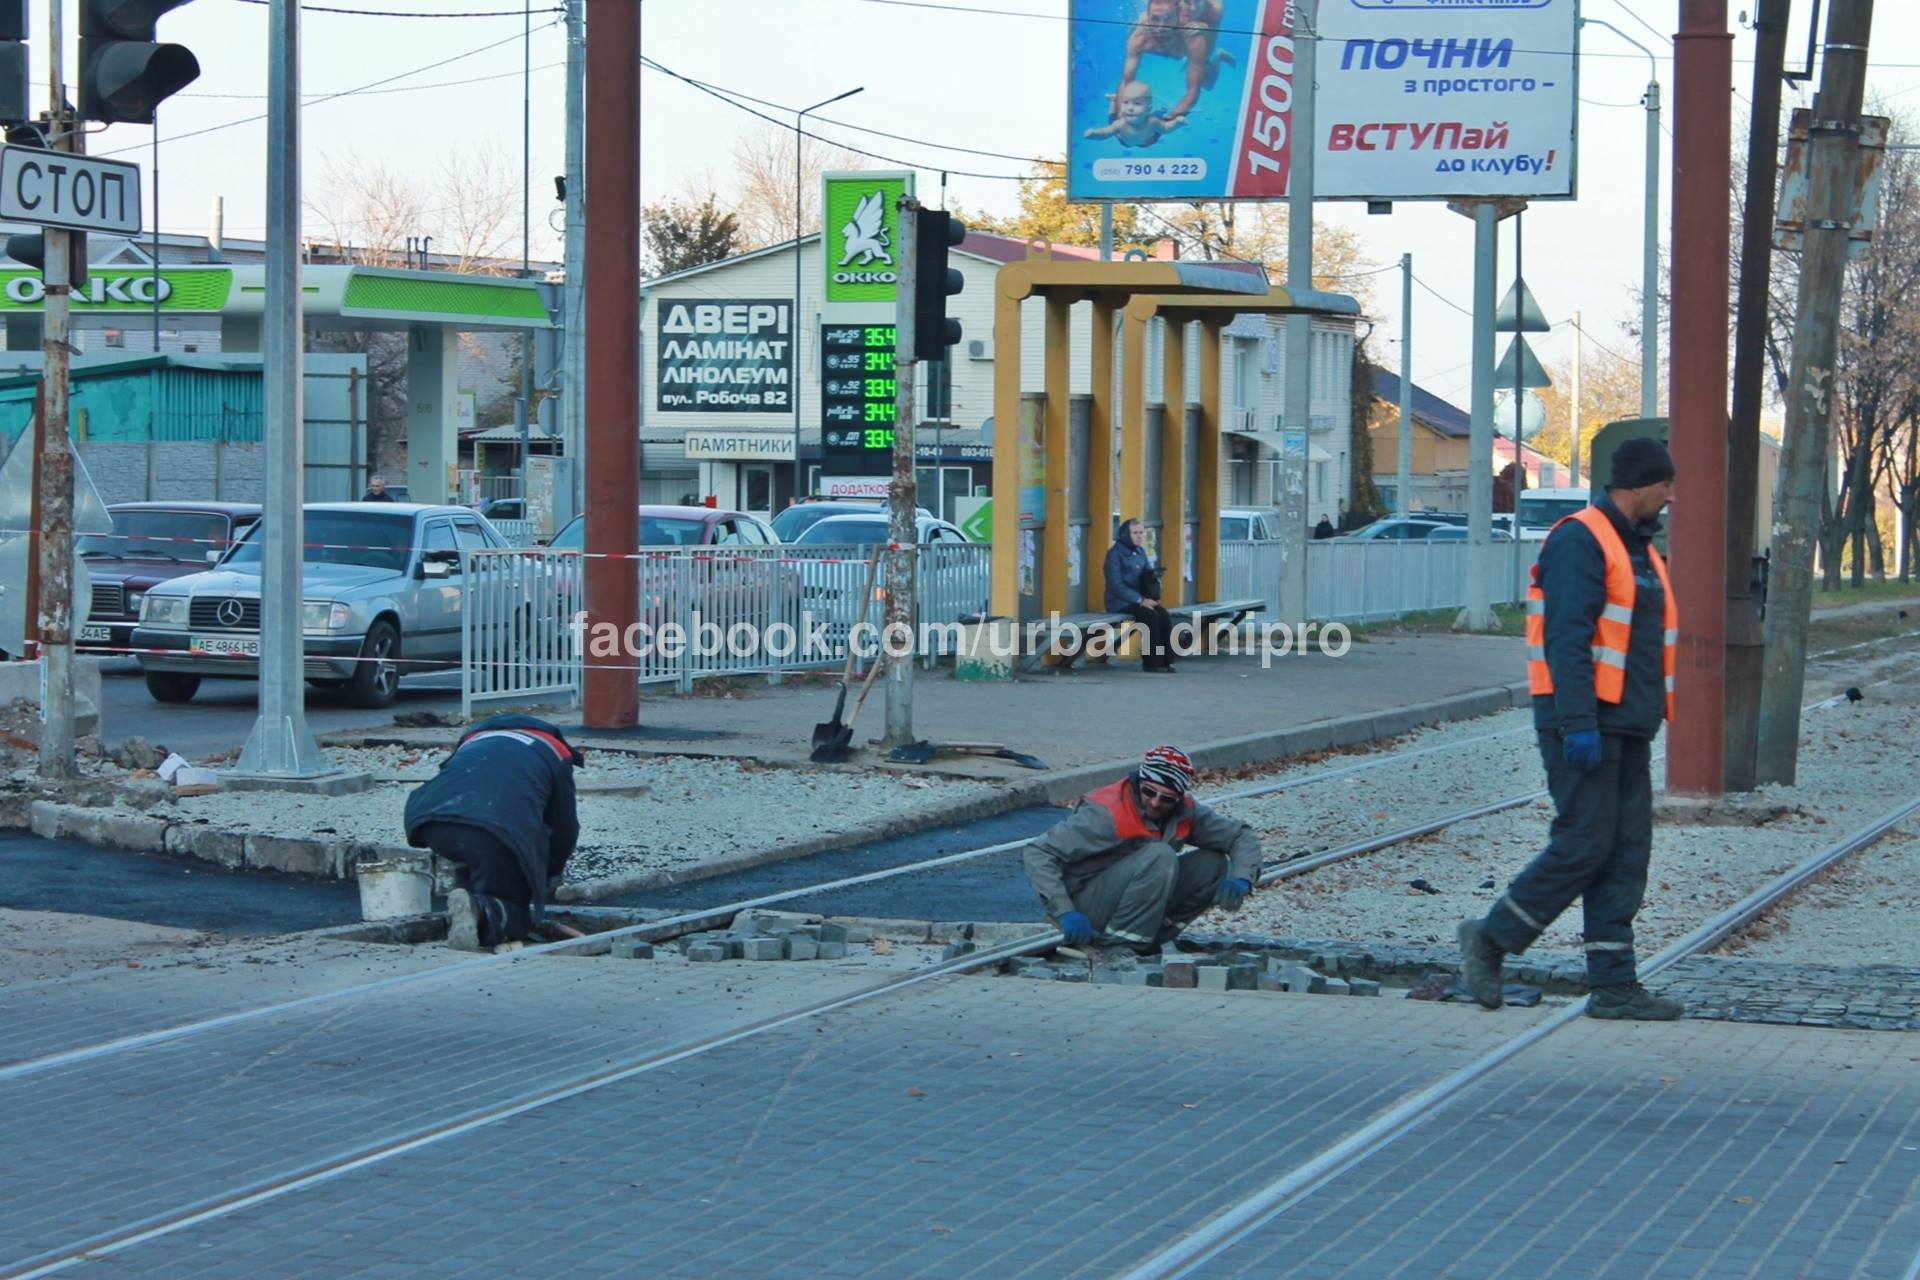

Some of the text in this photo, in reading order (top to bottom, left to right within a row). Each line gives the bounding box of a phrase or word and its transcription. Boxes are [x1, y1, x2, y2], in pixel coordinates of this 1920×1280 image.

[1340, 38, 1513, 70] ПОЧНИ
[1404, 79, 1417, 93] з
[1423, 78, 1536, 96] простого
[1248, 35, 1295, 175] 1500
[1327, 121, 1509, 151] ВСТУПай
[1125, 164, 1152, 175] 790
[1157, 164, 1166, 175] 4
[1171, 164, 1199, 175] 222
[1435, 149, 1556, 175] до клубу!
[17, 161, 125, 221] СТОП
[832, 271, 897, 284] OKKO
[662, 304, 789, 334] ДВЕРІ
[662, 340, 788, 360] ЛАМІНАТ
[662, 367, 788, 384] ЛІНОЛЕУМ
[662, 391, 787, 406] вул. Робоча 82
[688, 437, 792, 453] ПАМЯТНИКИ
